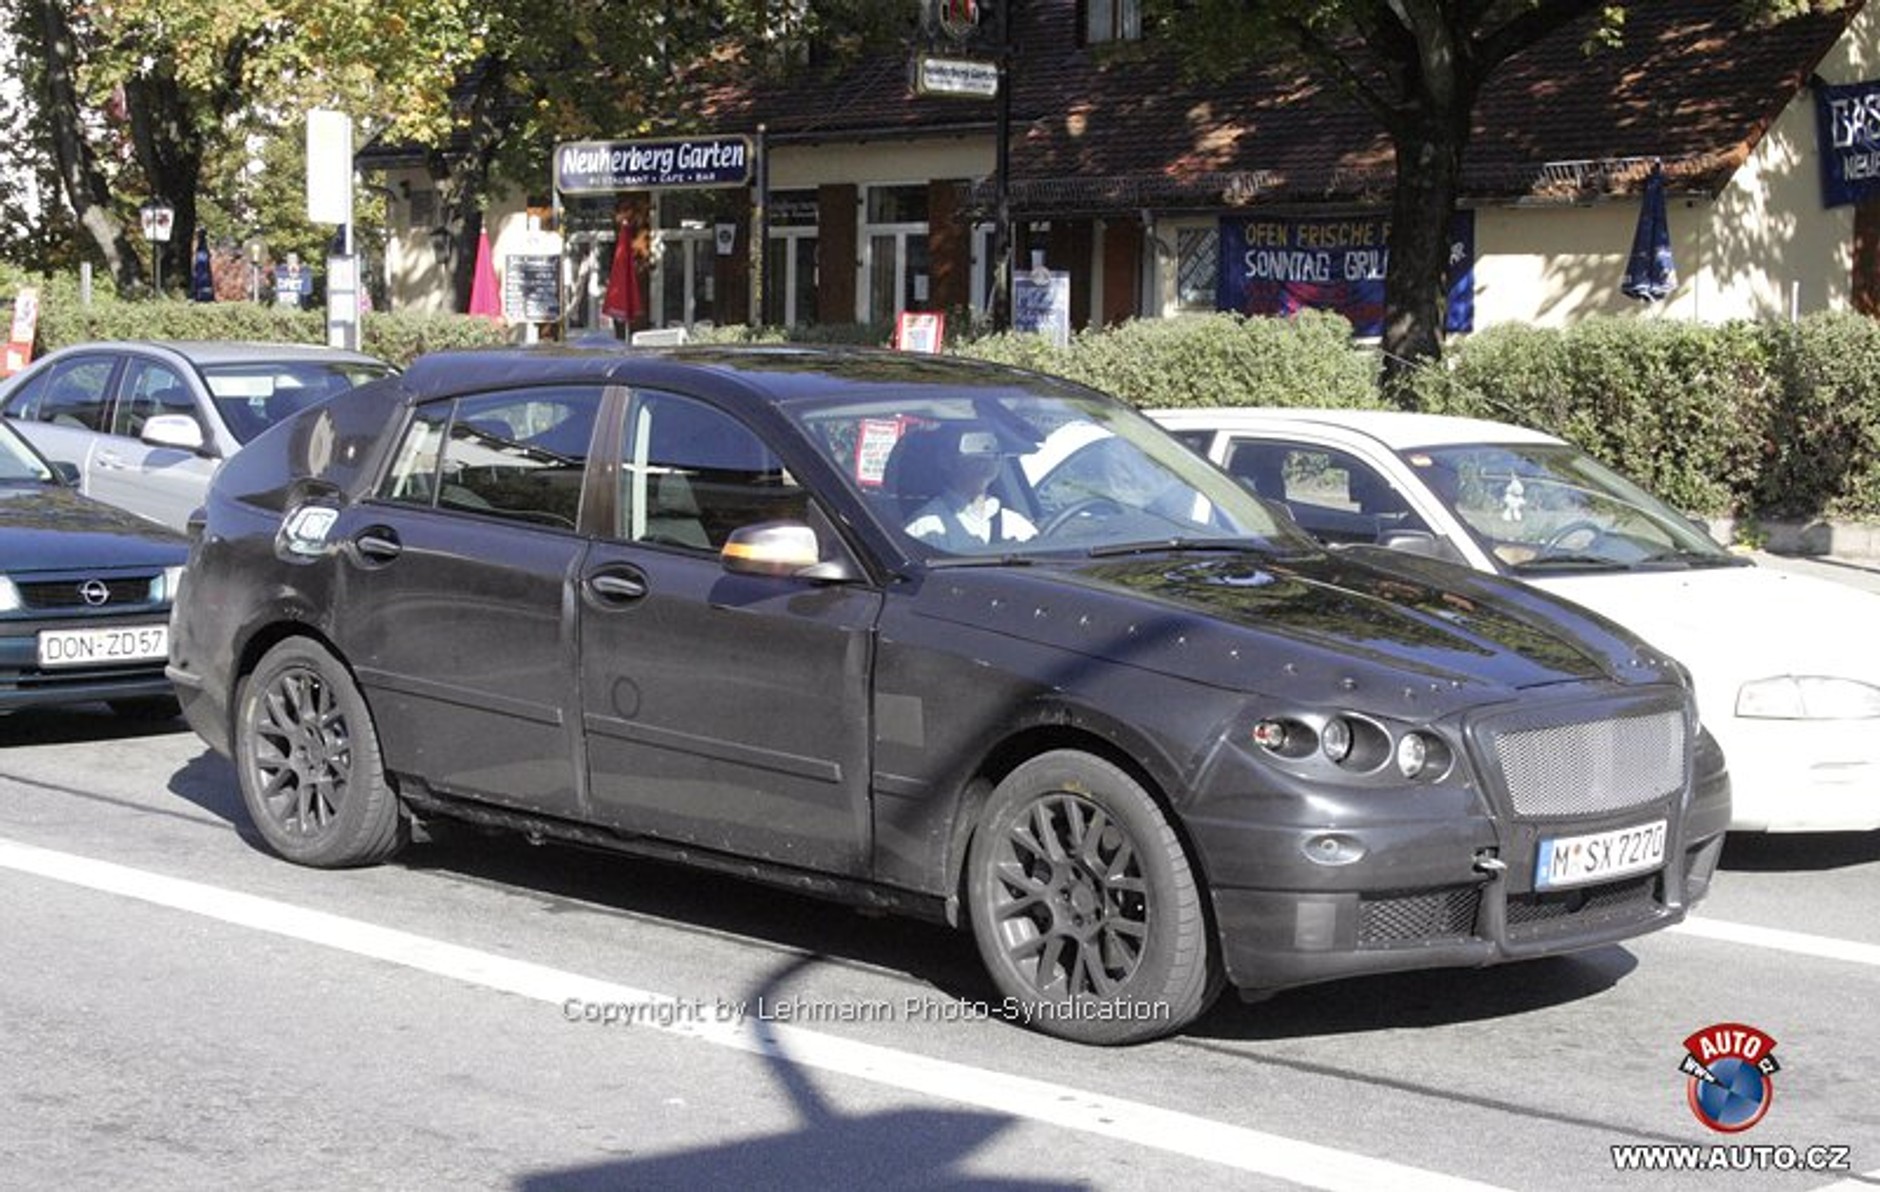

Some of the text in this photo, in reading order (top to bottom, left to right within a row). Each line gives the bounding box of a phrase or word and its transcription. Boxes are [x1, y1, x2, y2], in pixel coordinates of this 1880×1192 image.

[562, 141, 744, 174] Neuherberg Garten
[1245, 222, 1287, 246] OFEN
[1296, 222, 1374, 248] FRISCHE
[1245, 249, 1331, 281] SONNTAG
[140, 630, 162, 654] 57
[1554, 825, 1663, 876] M SX 7270
